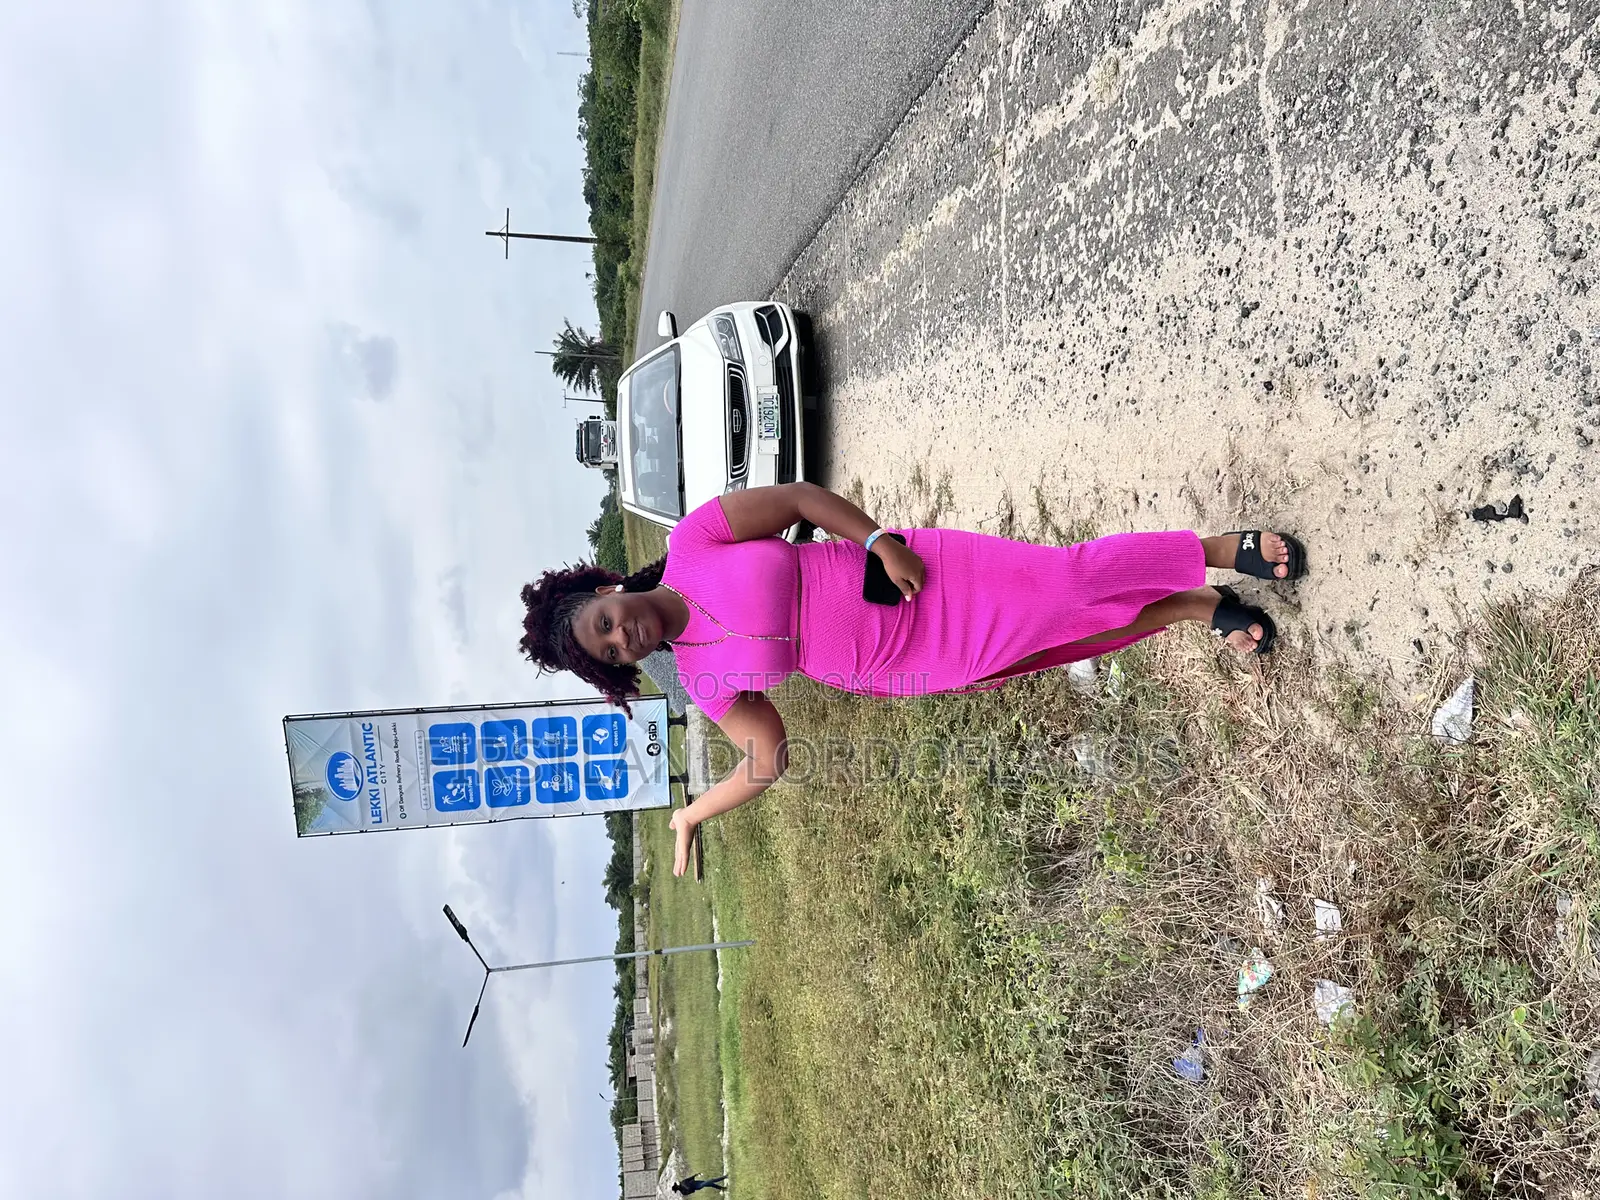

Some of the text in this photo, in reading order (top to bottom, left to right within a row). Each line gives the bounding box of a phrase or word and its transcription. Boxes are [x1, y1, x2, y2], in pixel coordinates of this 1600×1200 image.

[648, 720, 658, 741] GIDI
[362, 722, 383, 824] LEKKI ATLANTIC
[394, 764, 402, 784] Refinery
[397, 784, 405, 804] Dangote
